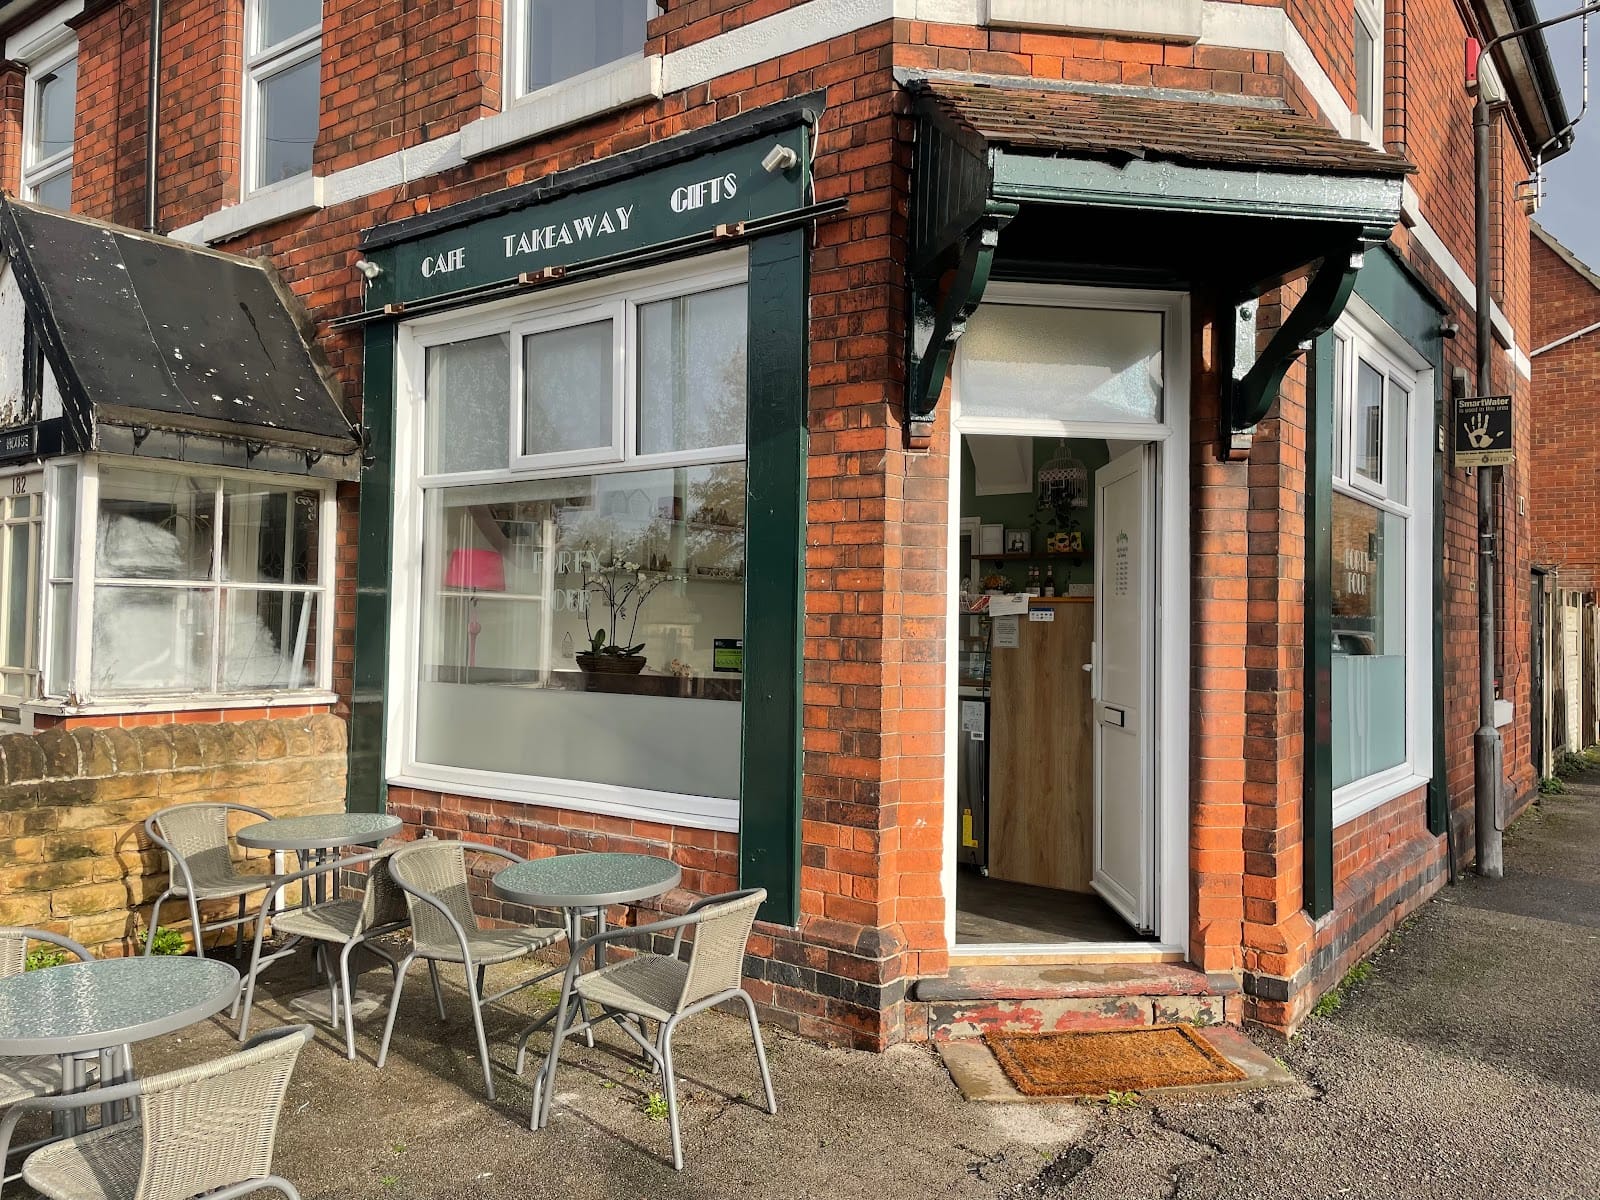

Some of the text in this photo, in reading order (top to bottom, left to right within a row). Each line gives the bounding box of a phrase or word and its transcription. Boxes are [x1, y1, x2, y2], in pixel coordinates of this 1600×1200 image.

[421, 172, 737, 278] CAFE TAKEAWAY GIFTS
[1459, 398, 1509, 408] SmartWater
[12, 476, 26, 495] 182
[533, 549, 601, 574] FRTY
[1344, 548, 1369, 573] FORTY
[1348, 572, 1367, 596] FOUR
[545, 588, 593, 613] OUR
